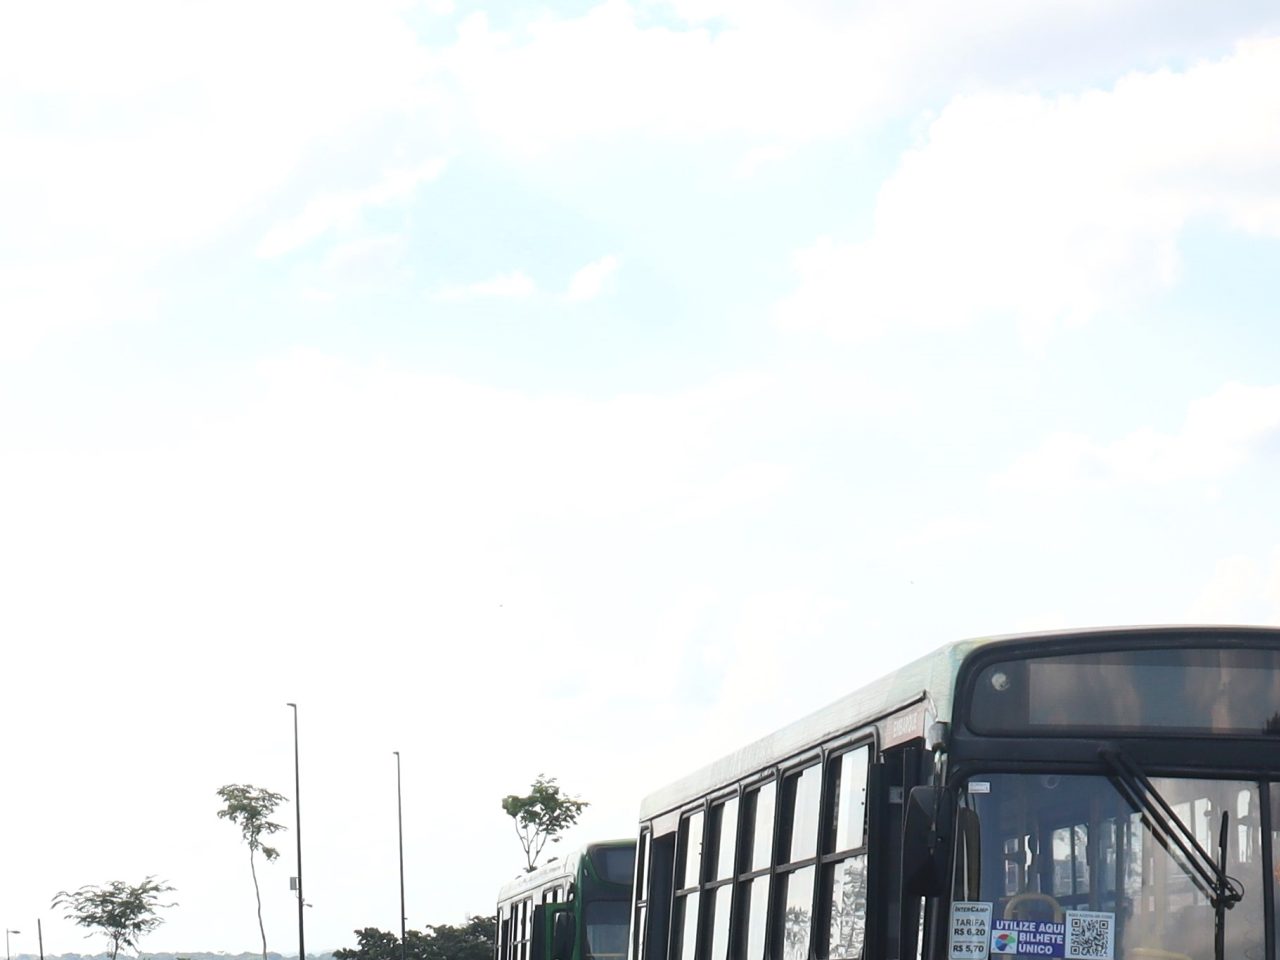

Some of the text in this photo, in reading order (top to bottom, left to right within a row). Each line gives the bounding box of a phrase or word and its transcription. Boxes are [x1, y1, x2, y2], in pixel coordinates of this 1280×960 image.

[955, 919, 985, 927] TARIFA
[996, 920, 1064, 934] UTILIZE AQUI
[954, 928, 985, 936] R$ 6,20
[1019, 933, 1064, 944] BILHETE
[953, 944, 984, 953] R$ 5,70
[1018, 942, 1053, 954] ÚNICO
